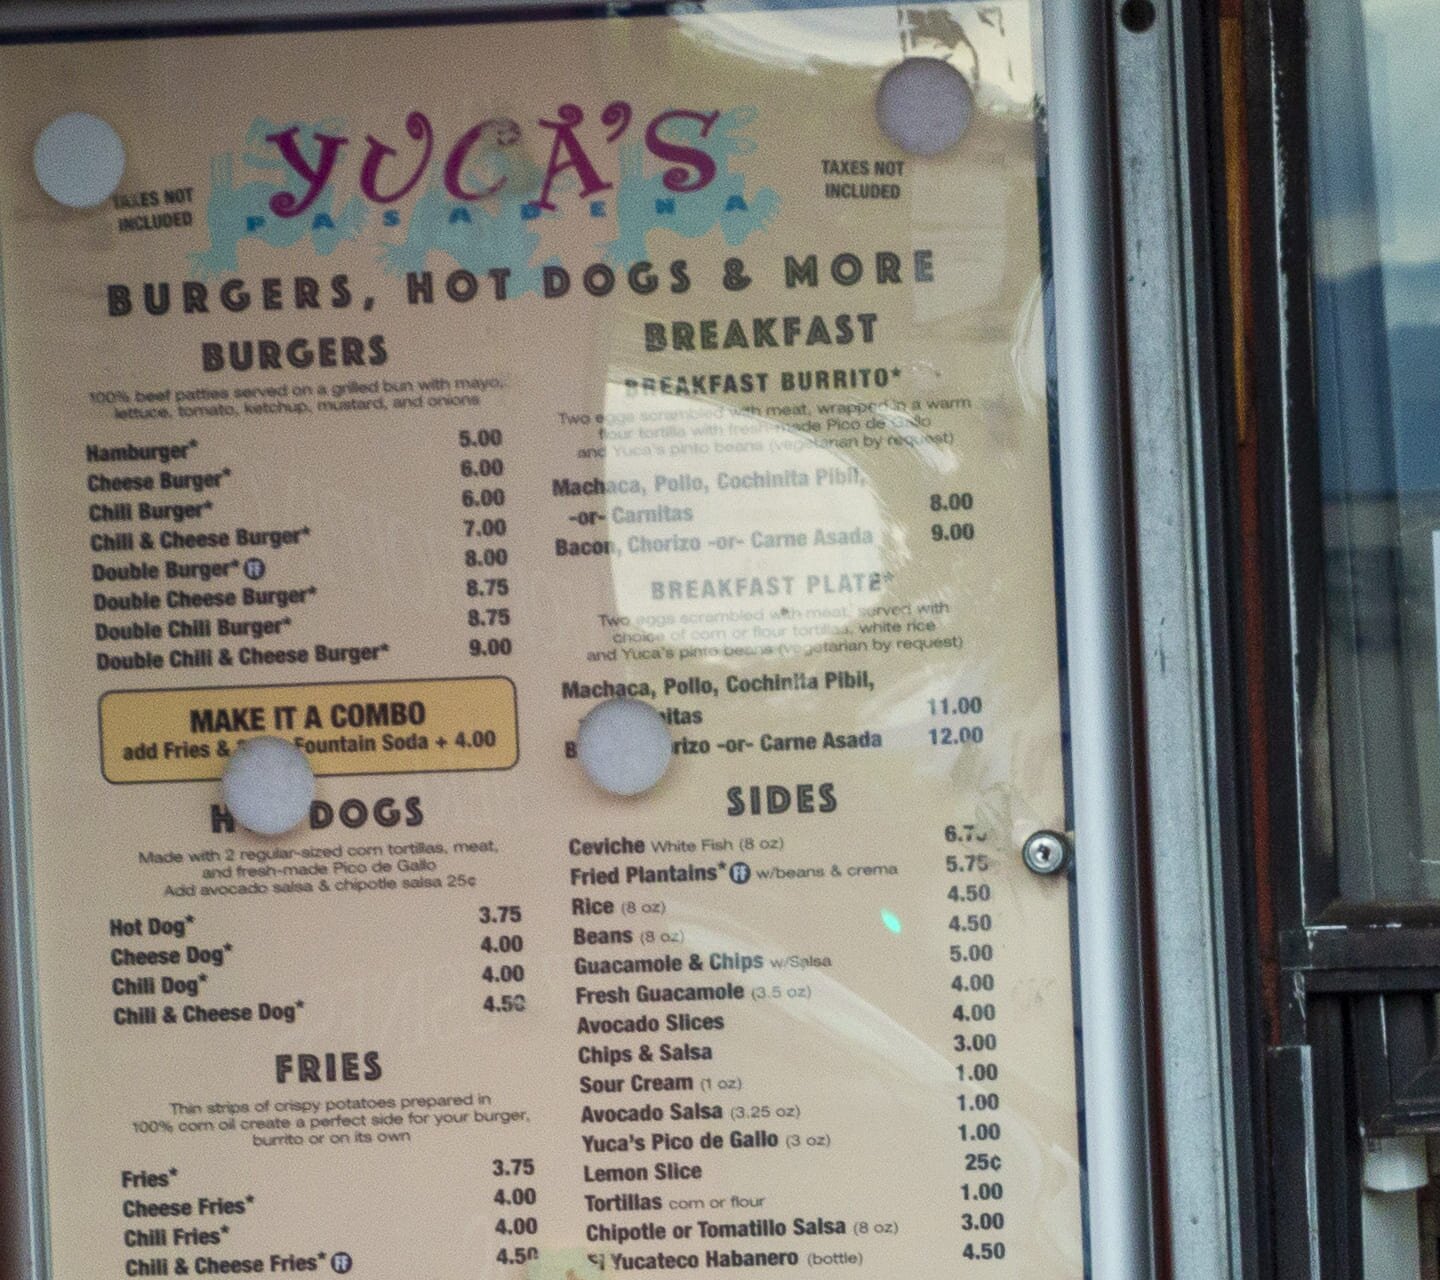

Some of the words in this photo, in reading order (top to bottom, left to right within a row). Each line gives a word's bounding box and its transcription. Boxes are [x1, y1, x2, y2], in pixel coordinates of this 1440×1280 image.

[821, 159, 870, 176] TAXES
[874, 160, 904, 176] NOT
[825, 183, 900, 199] INCLUDED
[247, 195, 749, 231] PASADENA
[107, 274, 375, 316] BURGERS,
[407, 268, 510, 304] HOT
[543, 259, 691, 298] DOGS
[723, 257, 751, 291] &
[785, 249, 934, 289] MORE
[202, 335, 388, 371] BURGERS
[645, 313, 878, 352] BREAKFAST
[459, 429, 502, 447] 5.00
[190, 708, 265, 733] MAKE
[274, 706, 297, 729] IT
[304, 705, 322, 728] A
[330, 701, 426, 727] COMBO
[309, 796, 424, 829] DOGS
[727, 783, 838, 816] SIDES
[569, 837, 645, 856] Ceviche
[651, 840, 696, 853] White
[702, 837, 733, 851] Fish
[276, 1051, 382, 1083] FRIES
[584, 1165, 648, 1182] Lemon
[655, 1163, 702, 1180] Slice
[965, 1153, 1001, 1171] 25¢
[586, 1224, 666, 1243] Chipotle
[673, 1224, 689, 1239] or
[700, 1220, 787, 1237] Tomatillo
[793, 1219, 846, 1235] Salsa
[961, 1213, 1004, 1230] 3.00
